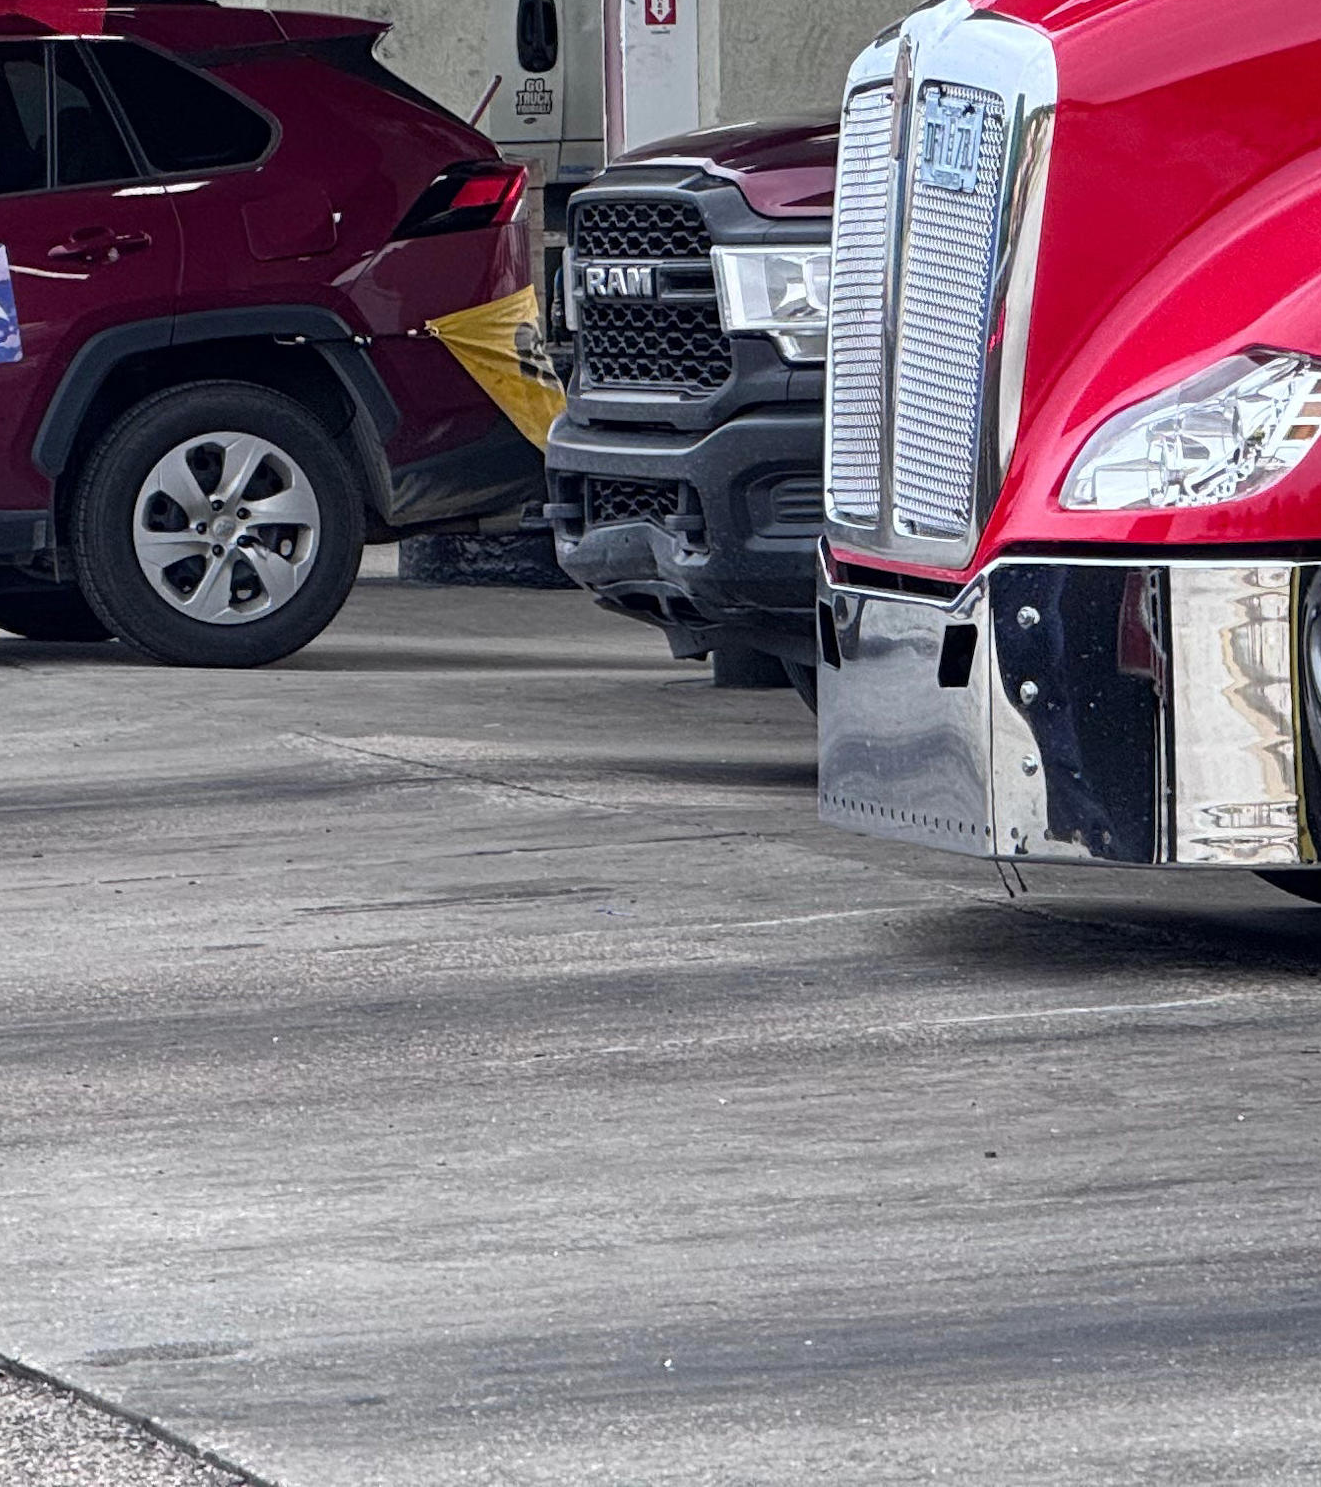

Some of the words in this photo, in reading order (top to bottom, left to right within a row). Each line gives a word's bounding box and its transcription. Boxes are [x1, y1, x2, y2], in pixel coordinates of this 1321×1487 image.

[527, 80, 544, 91] GO
[518, 92, 551, 105] TRUCK
[586, 267, 653, 298] RAM
